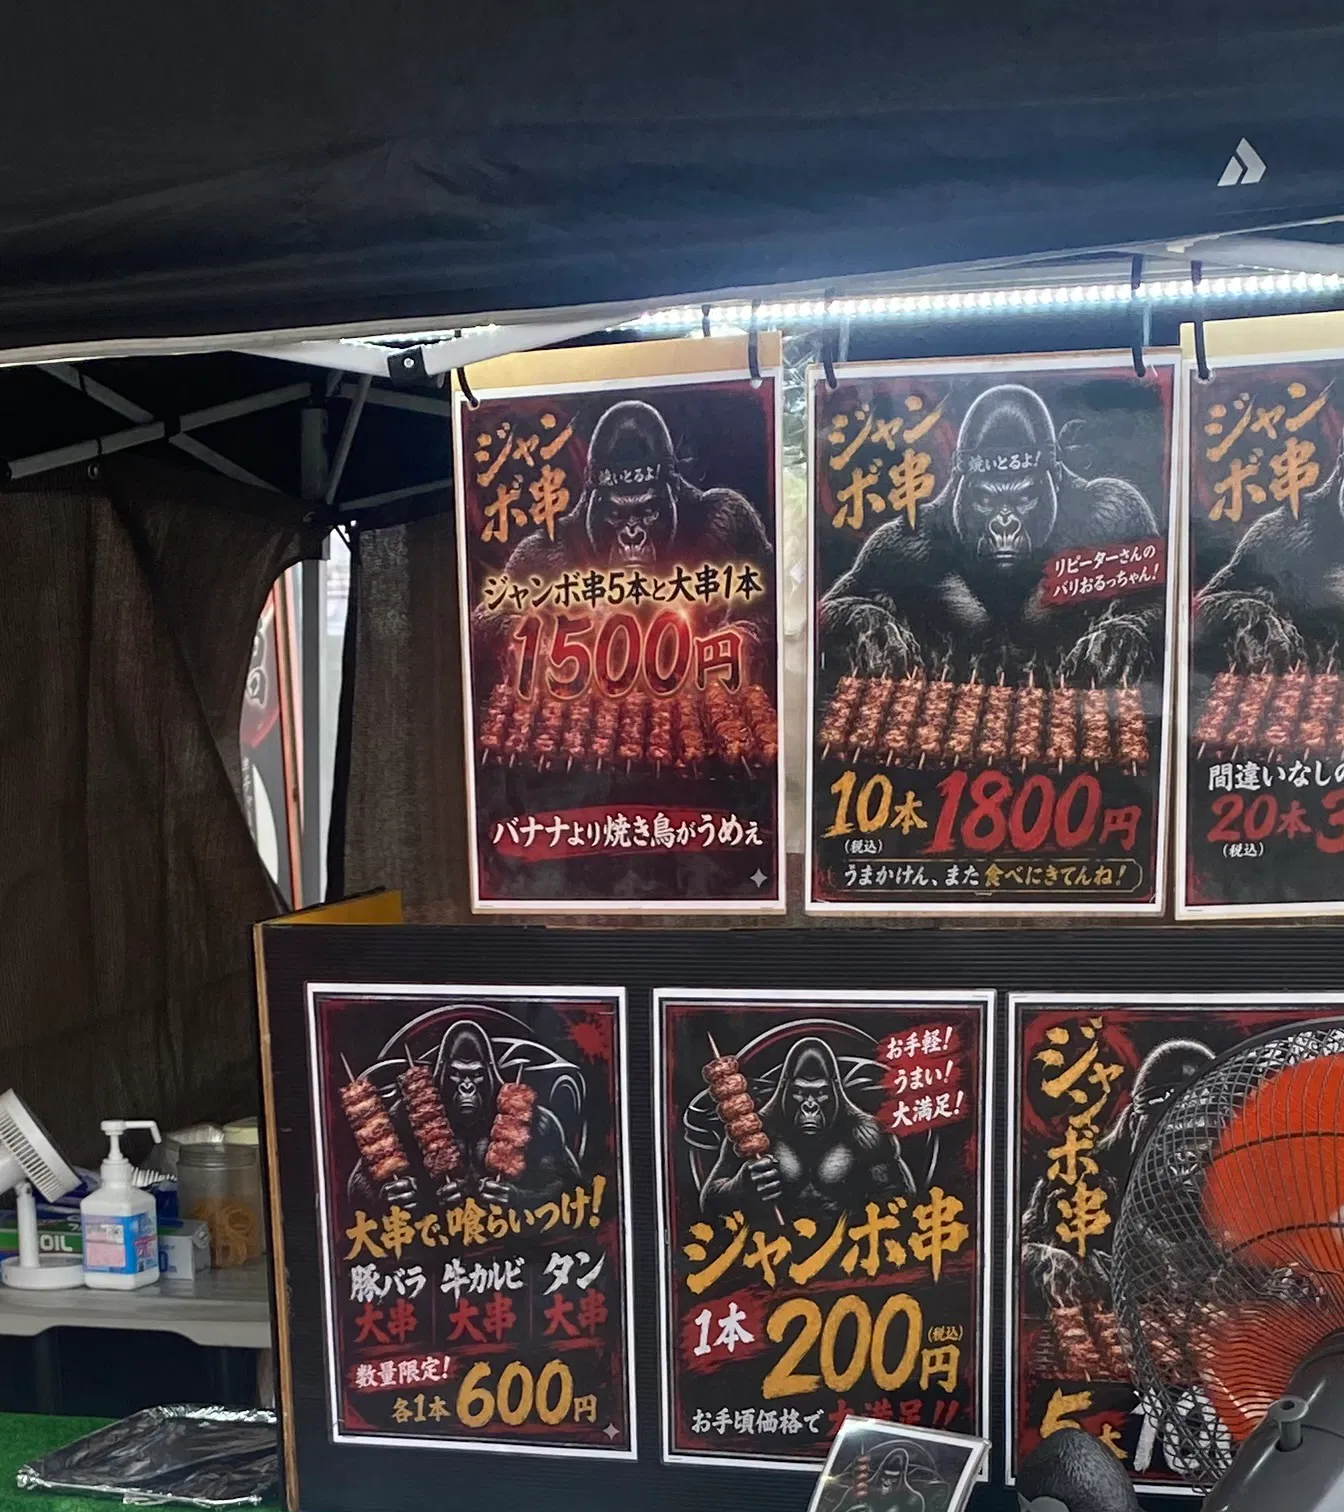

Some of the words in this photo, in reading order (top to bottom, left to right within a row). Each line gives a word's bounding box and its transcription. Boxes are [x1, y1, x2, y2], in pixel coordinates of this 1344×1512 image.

[828, 393, 950, 471] ジャン
[1204, 378, 1335, 462] ジャン
[475, 411, 580, 487] ジャン
[967, 451, 1042, 474] 焼いとるよ!
[480, 465, 570, 543] ボ串
[832, 448, 935, 530] ボ串
[1208, 436, 1320, 522] ボ串
[485, 563, 764, 611] ジャンボ串5本と大串1本
[1053, 563, 1160, 597] バリおるっちゃん!
[1055, 545, 1156, 576] リピーターさんの
[515, 611, 742, 701] 1500円
[820, 769, 928, 839] 10本
[923, 770, 1142, 855] 1800円
[1207, 794, 1311, 843] 20本
[886, 1026, 953, 1060] お手軽!
[894, 1060, 953, 1094] うまい!
[891, 1091, 964, 1128] 大満足!
[1036, 1016, 1125, 1258] ジャンボ串
[40, 1234, 72, 1252] OIL
[682, 1186, 969, 1295] ジャンボ串
[350, 1262, 428, 1303] 豚バラ
[441, 1257, 525, 1300] 牛カルビ
[543, 1251, 606, 1296] タン
[355, 1298, 417, 1343] 大串
[447, 1292, 516, 1343] 大串
[543, 1288, 608, 1338] 大串
[354, 1356, 452, 1388] 数量限定!
[693, 1302, 754, 1356] 1本
[761, 1293, 960, 1400] 200円
[391, 1394, 451, 1423] 各1本
[457, 1359, 597, 1428] 600円
[691, 1408, 824, 1435] お手頃価格で
